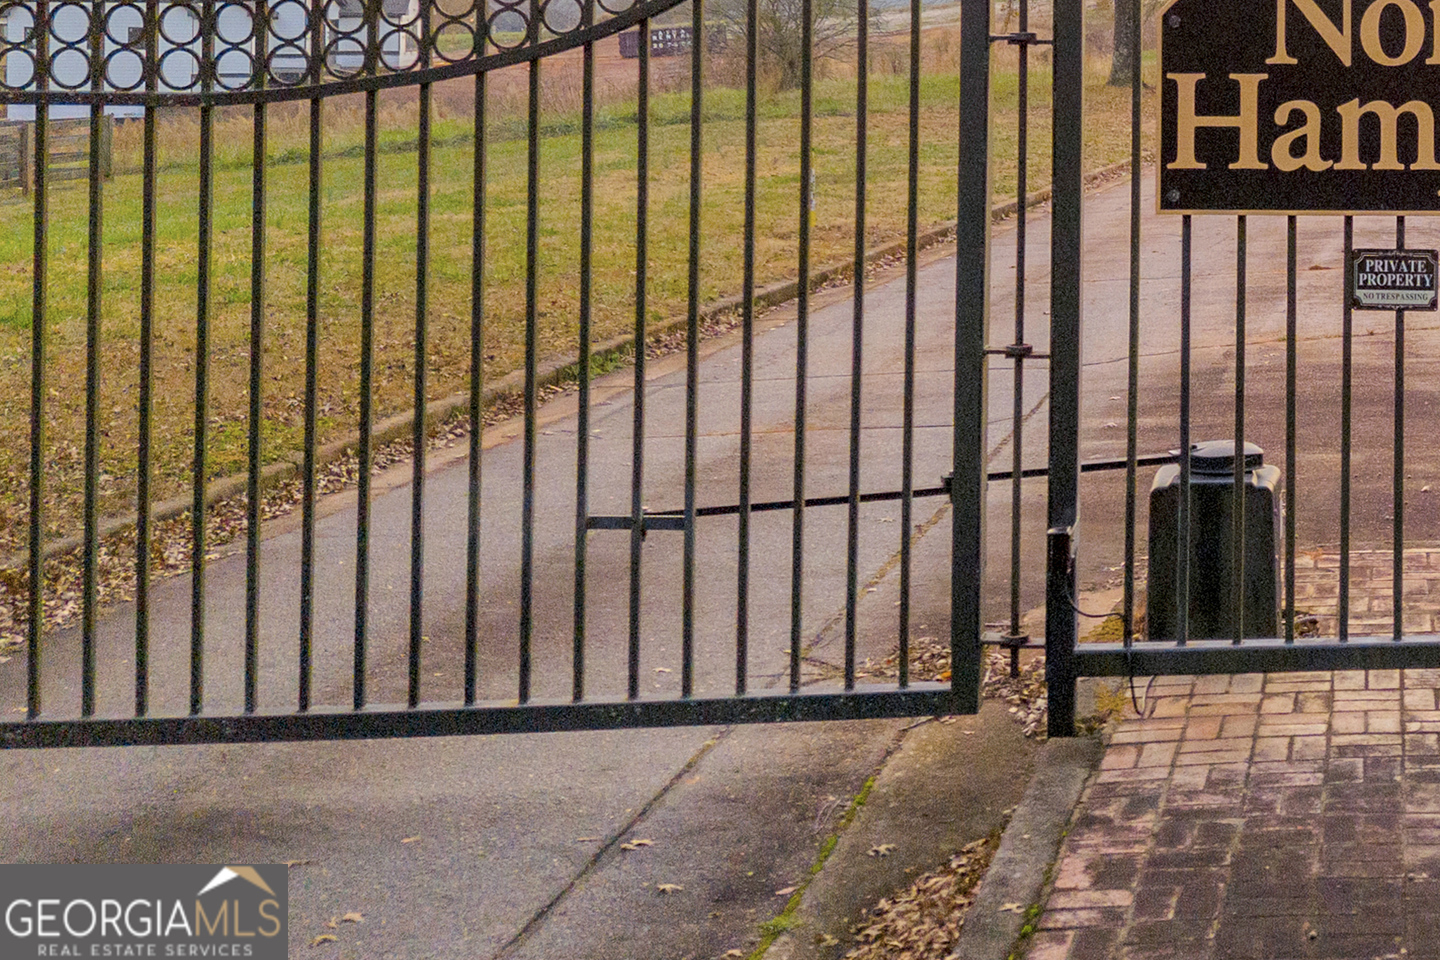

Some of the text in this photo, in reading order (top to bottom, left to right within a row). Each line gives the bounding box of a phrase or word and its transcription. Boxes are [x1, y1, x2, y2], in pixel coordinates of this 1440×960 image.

[1365, 259, 1427, 273] PRIVATE
[1358, 273, 1433, 287] PROPERTY
[1363, 292, 1428, 301] NO TRESPASSING
